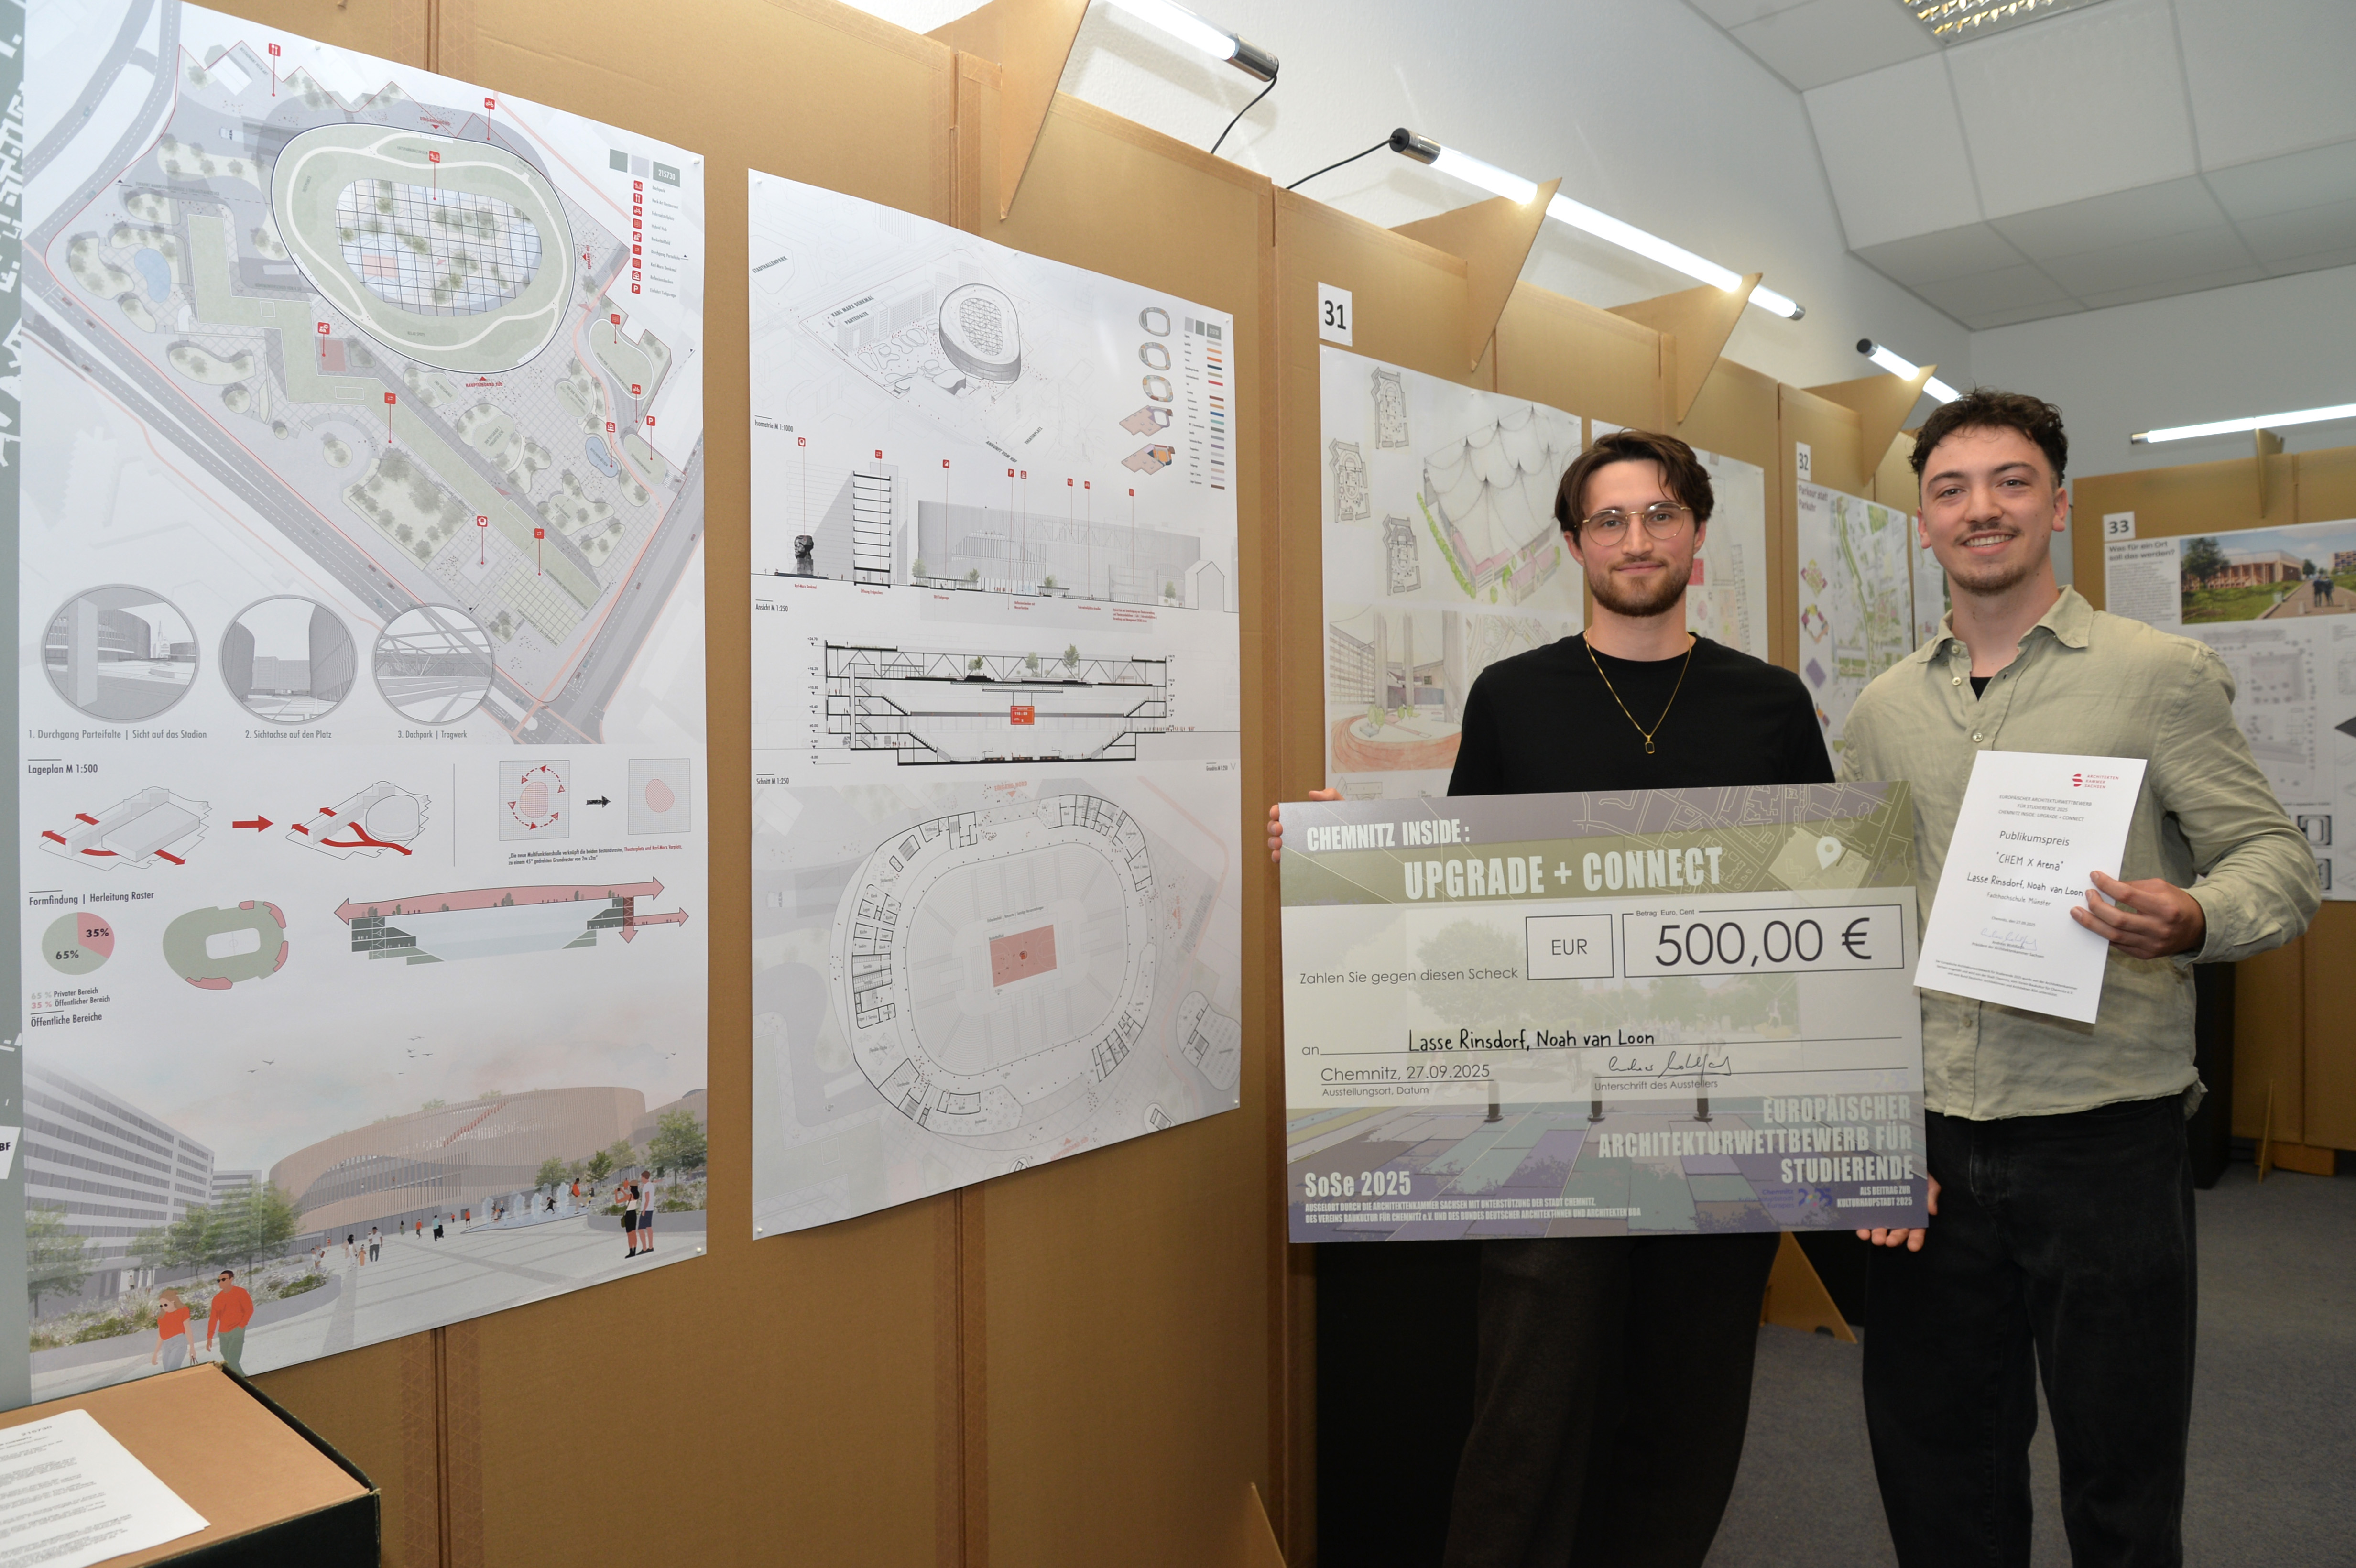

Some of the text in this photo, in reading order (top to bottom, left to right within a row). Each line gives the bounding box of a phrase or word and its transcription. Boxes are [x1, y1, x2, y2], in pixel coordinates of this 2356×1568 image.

[658, 169, 676, 180] 215730
[752, 256, 788, 273] STADTHALLENPARK
[831, 295, 874, 317] KARL MARX DENKMAL
[844, 311, 869, 325] PARTEIFALTE
[1324, 300, 1346, 330] 31
[754, 420, 774, 428] Isometrie
[780, 424, 794, 432] 1:1000
[1799, 452, 1809, 471] 32
[2109, 520, 2129, 534] 33
[2140, 549, 2175, 558] werden?
[29, 730, 207, 740] 1. Durchgang Parteifalte Sicht auf das Stadion
[254, 730, 287, 739] Sichtachse
[289, 730, 300, 738] auf
[302, 730, 314, 738] den
[316, 730, 332, 738] Platz
[405, 730, 433, 740] Dachpark
[441, 730, 467, 740] Tragwerk
[28, 764, 98, 775] Lageplan M 1:500
[2031, 797, 2092, 806] ARCHITEKTURWETTBEWERB
[1307, 823, 1395, 851] CHEMNITZ
[1999, 830, 2070, 846] Publikumspreis
[2027, 858, 2034, 867] X
[1404, 847, 1723, 900] UPGRADE + CONNECT
[1967, 872, 2083, 897] Lasse Rinsdorf, Noah van Loon
[29, 891, 154, 905] Formfindung Herleitung Raster
[1987, 892, 2051, 906] Fachhochschule Münster
[86, 928, 109, 937] 35%
[1551, 938, 1588, 956] EUR
[1655, 917, 1872, 968] 500,00 €
[55, 950, 79, 960] 65%
[1300, 967, 1518, 985] Zahlen Sie gegen diesen Scheck
[54, 989, 76, 998] Privater
[55, 998, 88, 1007] Öffentlicher
[90, 995, 110, 1004] Bereich
[31, 1012, 102, 1027] Öffentliche Bereiche
[1302, 1028, 1654, 1056] an Lasse Rinsdorf, Noah van Loon
[1321, 1064, 1490, 1081] Chemnitz, 27.09.2025
[1322, 1086, 1429, 1098] Ausstellungsort, Datum
[1595, 1080, 1718, 1091] Unterschrift des Ausstellers
[1763, 1093, 1911, 1123] EUROPÄISCHER
[1599, 1121, 1912, 1157] ARCHITEKTURWETTBEWERB FÜR
[1781, 1156, 1913, 1183] STUDIERENDE
[1305, 1171, 1411, 1197] SoSe 2025
[1860, 1186, 1911, 1196] ALS BEITRAG ZUR
[1305, 1202, 1339, 1212] AUSGELOBT
[1341, 1202, 1362, 1211] DURCH
[1362, 1202, 1372, 1211] DIE
[1373, 1201, 1439, 1210] ARCHITEKTENKAMMER
[1440, 1200, 1467, 1209] SACHSEN
[1468, 1200, 1480, 1209] MIT
[1481, 1198, 1531, 1208] UNTERSTÜTZUNG
[1532, 1198, 1544, 1207] DER
[1544, 1198, 1563, 1207] STADT
[1896, 1197, 1913, 1206] 2025
[1306, 1215, 1318, 1223] DES
[1318, 1214, 1343, 1223] VEREINS
[1344, 1213, 1378, 1223] BAUKULTUR
[1379, 1212, 1391, 1222] FÜR
[1392, 1212, 1422, 1222] CHEMNITZ
[1423, 1213, 1433, 1221] e.V.
[1434, 1212, 1447, 1220] UND
[1448, 1212, 1460, 1220] DES
[1461, 1211, 1485, 1220] BUNDES
[1485, 1210, 1520, 1219] DEUTSCHER
[1573, 1209, 1586, 1218] UND
[1587, 1208, 1627, 1218] ARCHITEKTEN
[1628, 1208, 1641, 1217] BDA
